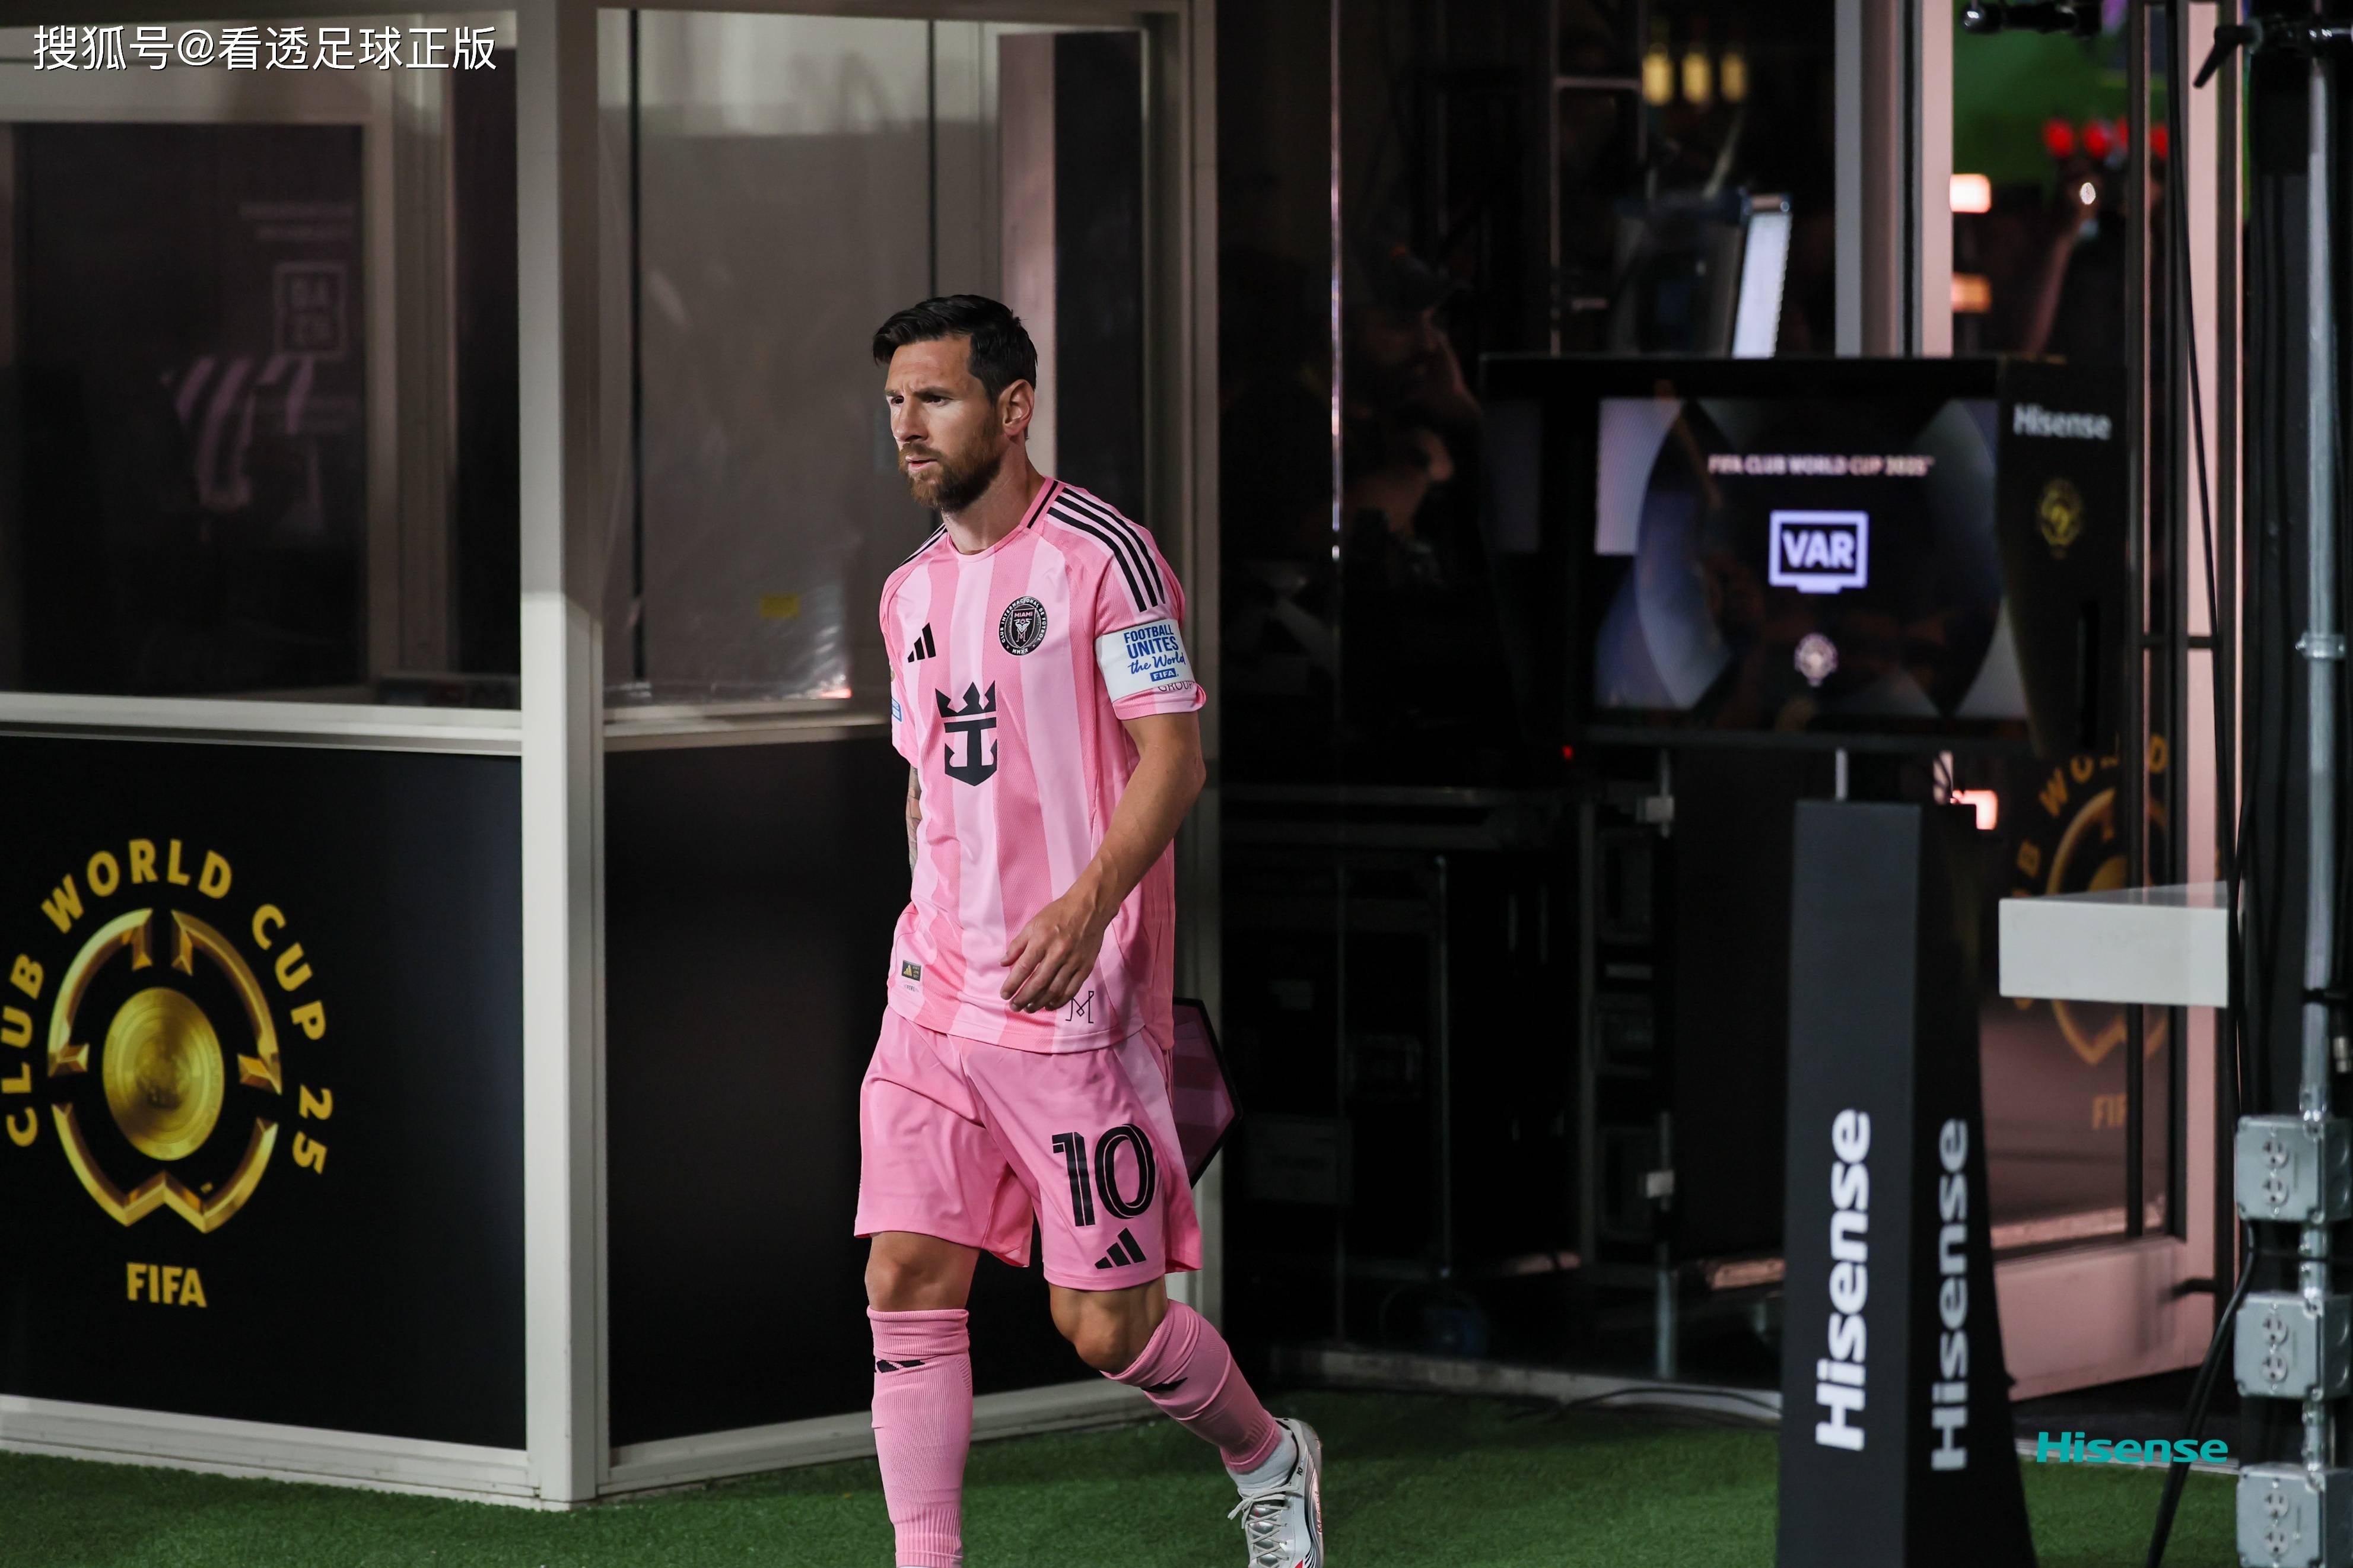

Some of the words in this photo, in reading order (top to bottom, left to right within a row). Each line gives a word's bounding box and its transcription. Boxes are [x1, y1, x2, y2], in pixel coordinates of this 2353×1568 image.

[2013, 403, 2112, 440] Hisense
[1849, 455, 1883, 475] CUP
[1782, 529, 1855, 569] VAR
[1123, 624, 1174, 644] FOOTBALL
[1126, 636, 1179, 659] UNITES
[1127, 660, 1152, 675] the
[1152, 651, 1186, 669] World
[1153, 672, 1175, 680] FIFA
[1, 954, 44, 1147] CLUB
[41, 839, 233, 934] WORLD
[252, 904, 326, 1041] CUP
[291, 1084, 333, 1174] 25
[1052, 1123, 1156, 1226] 10
[126, 1262, 207, 1308] FIFA
[1815, 1109, 1871, 1451] Hisense
[1931, 1119, 1969, 1471] Hisense
